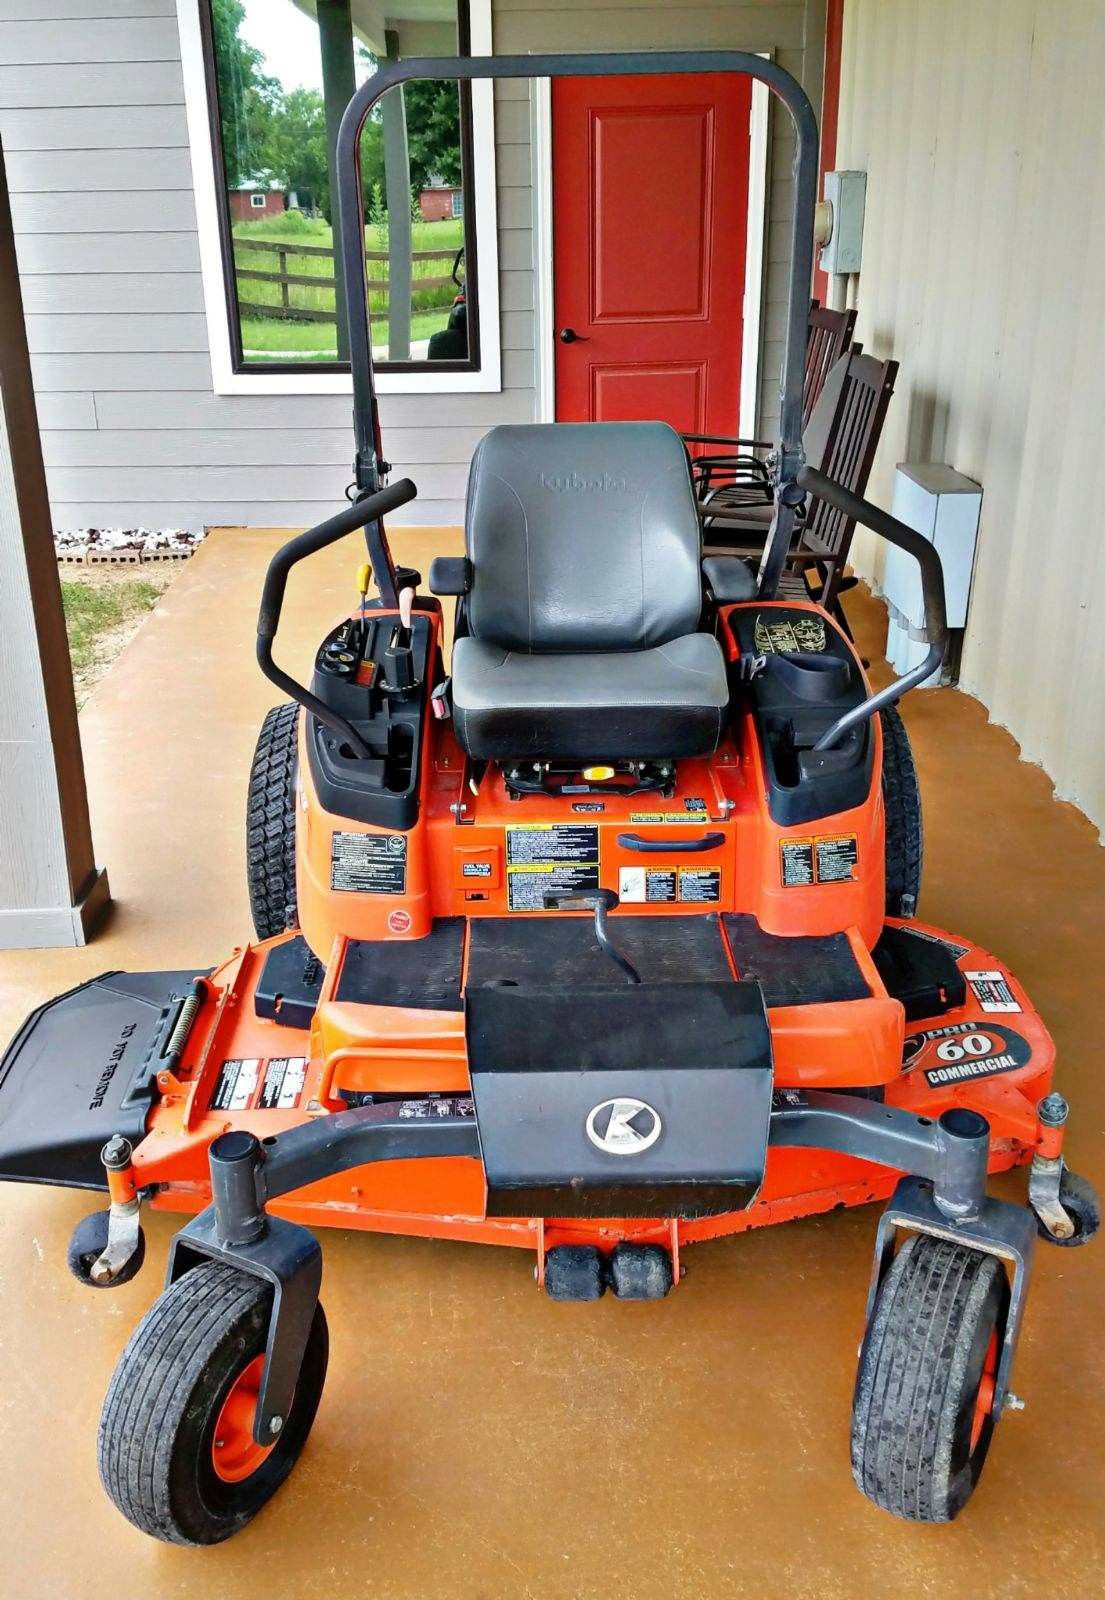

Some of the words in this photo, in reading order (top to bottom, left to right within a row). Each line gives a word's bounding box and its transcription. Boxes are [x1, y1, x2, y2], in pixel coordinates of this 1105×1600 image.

[120, 1022, 138, 1039] DO
[926, 1022, 978, 1039] PRO
[936, 1033, 993, 1061] 60
[927, 1054, 1019, 1084] COMMERCIAL
[88, 1062, 118, 1111] REMOVE
